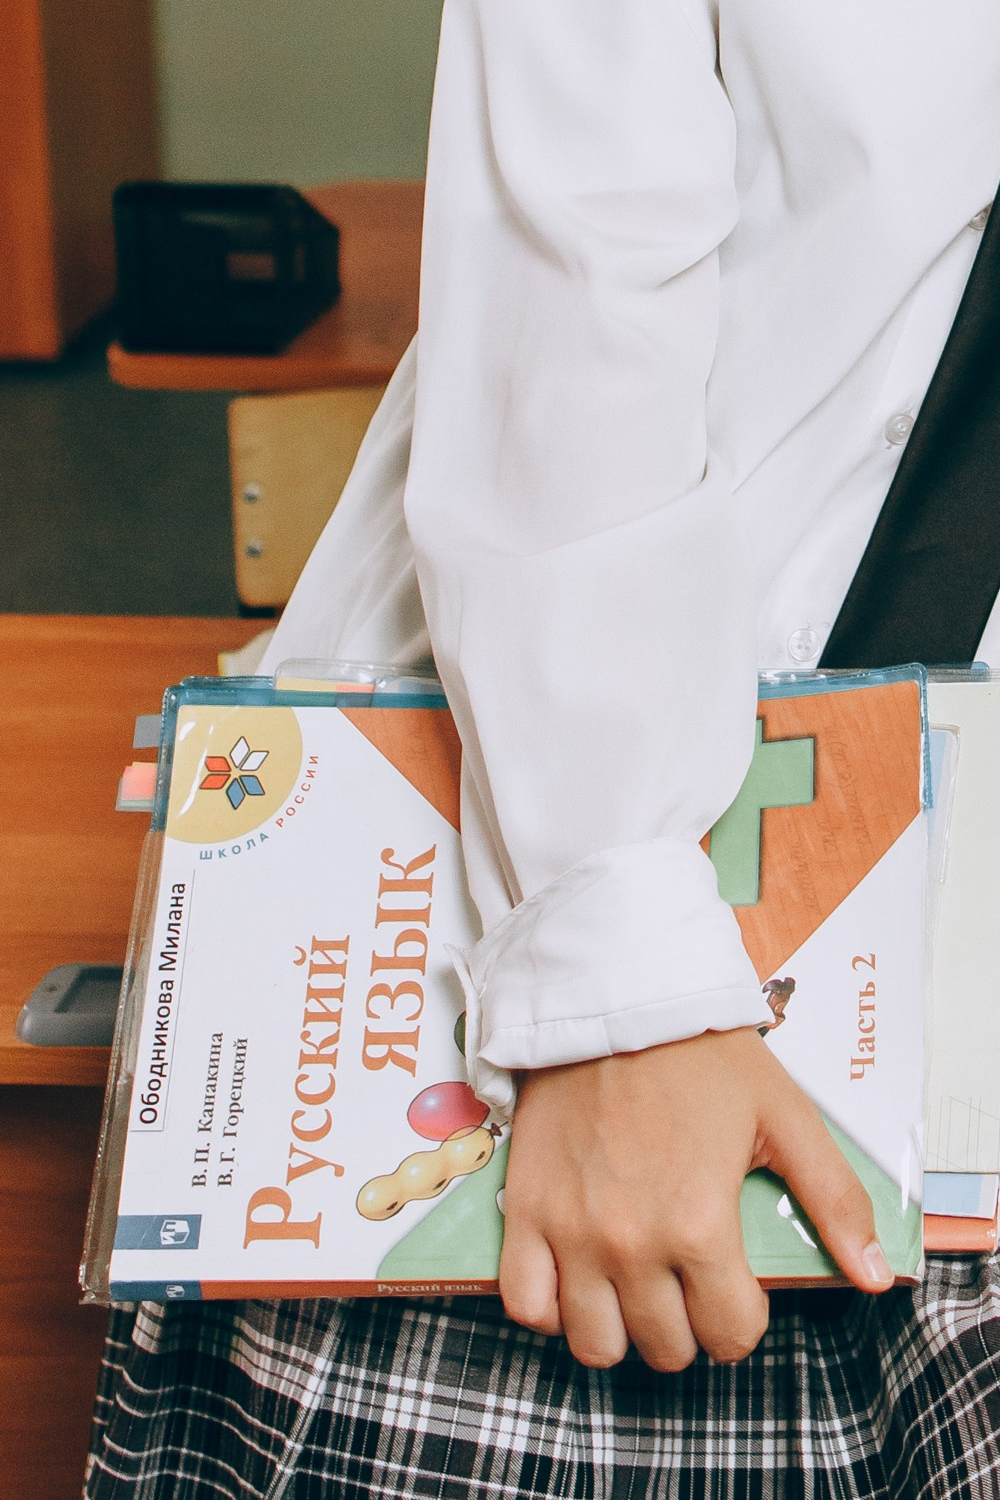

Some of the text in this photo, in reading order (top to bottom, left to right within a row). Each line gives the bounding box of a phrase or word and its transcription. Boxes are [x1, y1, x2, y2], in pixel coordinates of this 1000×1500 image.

[199, 754, 319, 861] ШКОЛА РОССИИ
[138, 882, 186, 1125] Ободникова Милана
[849, 952, 877, 1084] Часть 2
[191, 1031, 224, 1188] В. П. Канакина
[217, 1037, 248, 1188] В. Г. Горецкий
[243, 934, 350, 1250] Русский
[376, 1283, 441, 1294] Русский
